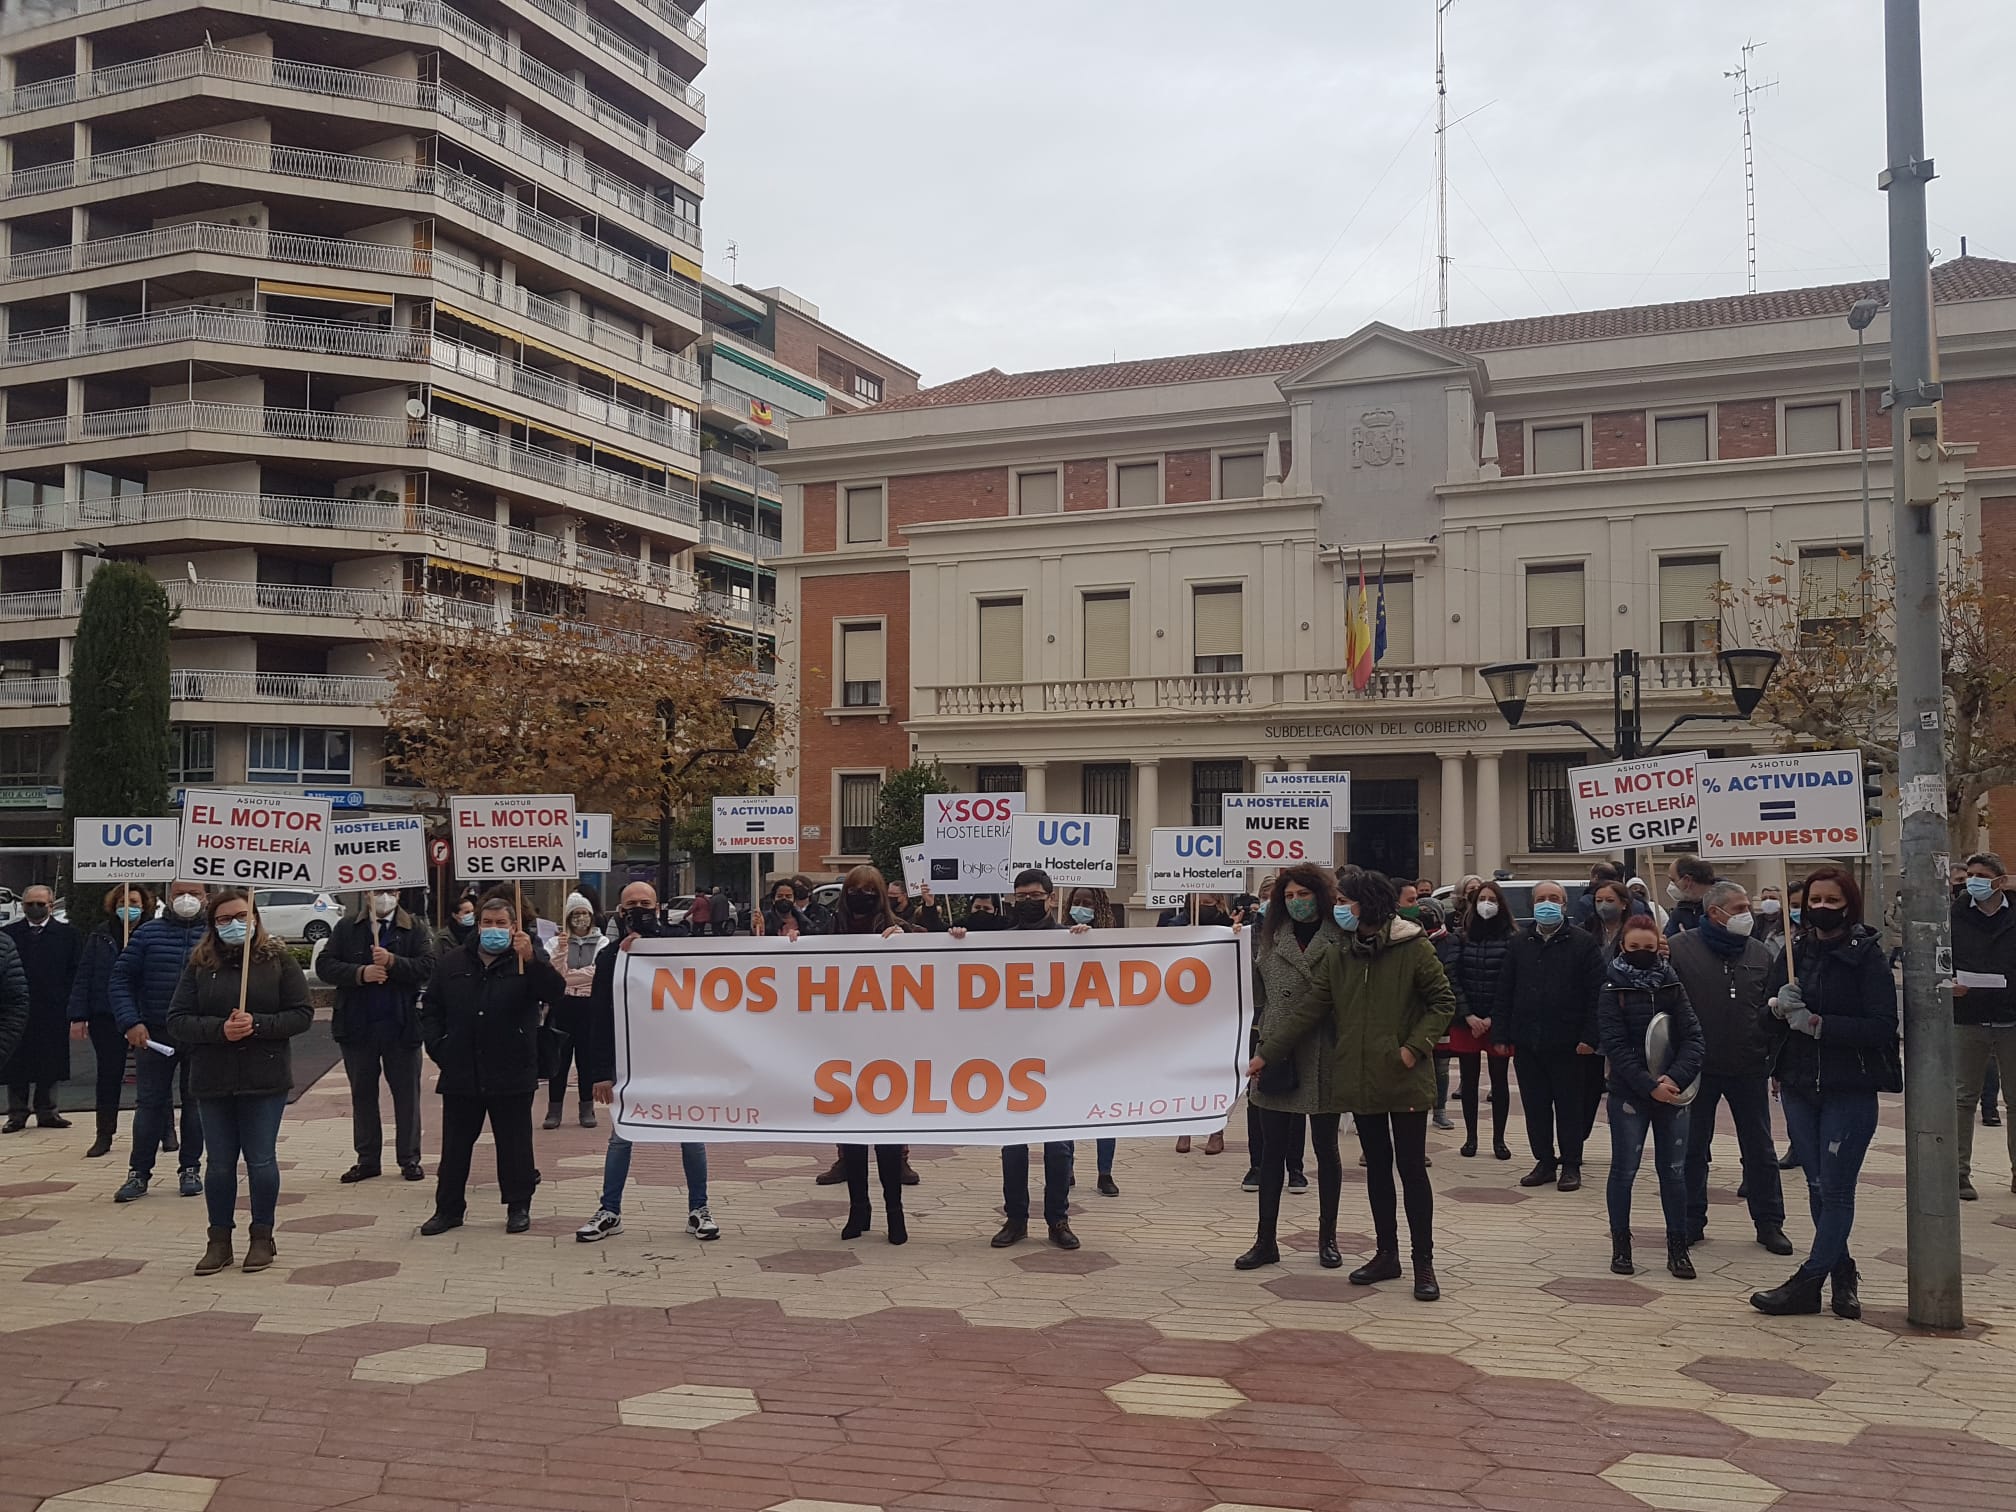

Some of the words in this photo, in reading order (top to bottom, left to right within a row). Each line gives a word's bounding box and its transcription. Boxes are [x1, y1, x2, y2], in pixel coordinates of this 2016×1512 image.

[1265, 723, 1373, 738] SUBDELEGACION
[1380, 722, 1407, 735] DEL
[1414, 719, 1487, 734] GOBIERNO
[1617, 762, 1659, 773] ASHOTUR
[1750, 760, 1800, 769] ASHOTUR
[1265, 776, 1278, 784] LA
[1281, 773, 1346, 784] HOSTELERÍA
[1702, 778, 1721, 793] %
[1727, 770, 1854, 792] ACTIVIDAD
[1578, 781, 1608, 799] EL
[237, 798, 281, 806] ASHOTUR
[1226, 798, 1243, 808] LA
[1247, 795, 1329, 808] HOSTELERÍA
[1589, 793, 1696, 819] HOSTELERÍA
[191, 805, 222, 825] EL
[230, 807, 322, 832] MOTOR
[459, 811, 485, 827] EL
[491, 809, 569, 827] MOTOR
[717, 807, 727, 816] %
[730, 806, 794, 816] ACTIVIDAD
[334, 818, 419, 834] HOSTELERÍA
[1245, 817, 1310, 830] MUERE
[102, 823, 152, 847] UCI
[467, 832, 563, 848] HOSTELERÍA
[717, 837, 727, 846] %
[730, 836, 795, 846] IMPUESTOS
[1038, 820, 1091, 846] UCI
[1591, 825, 1622, 844] SE
[1705, 833, 1723, 848] %
[1730, 827, 1859, 847] IMPUESTOS
[197, 834, 311, 855] HOSTELERÍA
[334, 839, 401, 856] MUERE
[577, 848, 608, 859] elería
[1175, 835, 1222, 857] UCI
[1247, 839, 1308, 860] S.O.S.
[77, 861, 97, 869] para
[99, 859, 107, 868] la
[110, 856, 174, 868] Hostelería
[193, 857, 225, 876] SE
[233, 859, 311, 881] GRIPA
[467, 856, 494, 873] SE
[501, 856, 566, 872] GRIPA
[1012, 861, 1031, 870] para
[1034, 860, 1042, 869] la
[1045, 857, 1113, 871] Hostelería
[338, 862, 402, 884] S.O.S.
[1153, 871, 1171, 879] para
[1173, 870, 1180, 878] la
[1183, 867, 1242, 878] Hostelería
[1152, 895, 1165, 905] SE
[651, 966, 778, 1013] NOS
[797, 964, 935, 1011] HAN
[957, 956, 1212, 1011] DEJADO
[813, 1057, 1048, 1115] SOLOS
[630, 1103, 760, 1125] ASHOTUR
[1086, 1094, 1228, 1119] ASHOTUR
